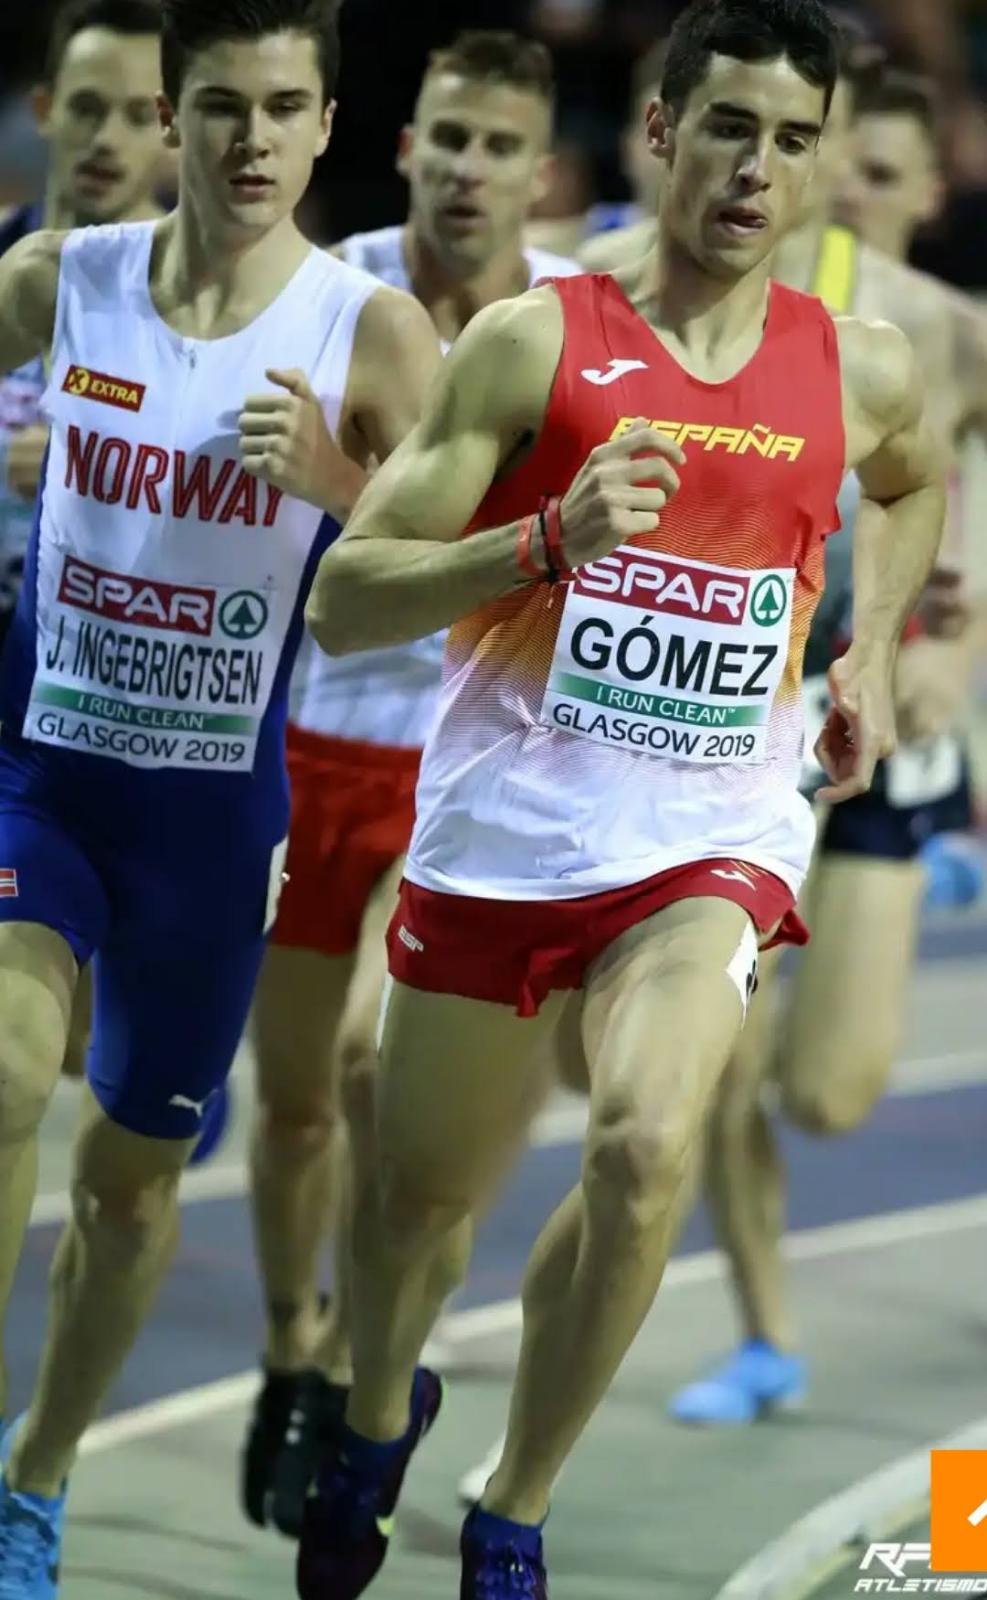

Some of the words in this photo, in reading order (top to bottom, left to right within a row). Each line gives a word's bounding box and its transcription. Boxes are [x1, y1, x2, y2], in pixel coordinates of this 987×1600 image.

[91, 380, 138, 404] EXTRA
[65, 425, 284, 527] NORWAY
[65, 564, 211, 629] SPAR
[580, 556, 744, 618] SPAR
[47, 615, 66, 672] J.
[73, 620, 263, 705] INGEBRIGTSEN
[570, 615, 779, 697] GÓMEZ
[78, 694, 85, 709] I
[90, 697, 131, 720] RUN
[596, 686, 604, 701] I
[608, 688, 655, 712] RUN
[38, 713, 178, 759] GLASGOW
[184, 739, 246, 763] 2019
[553, 703, 701, 756] GLASGOW
[703, 733, 756, 757] 2019
